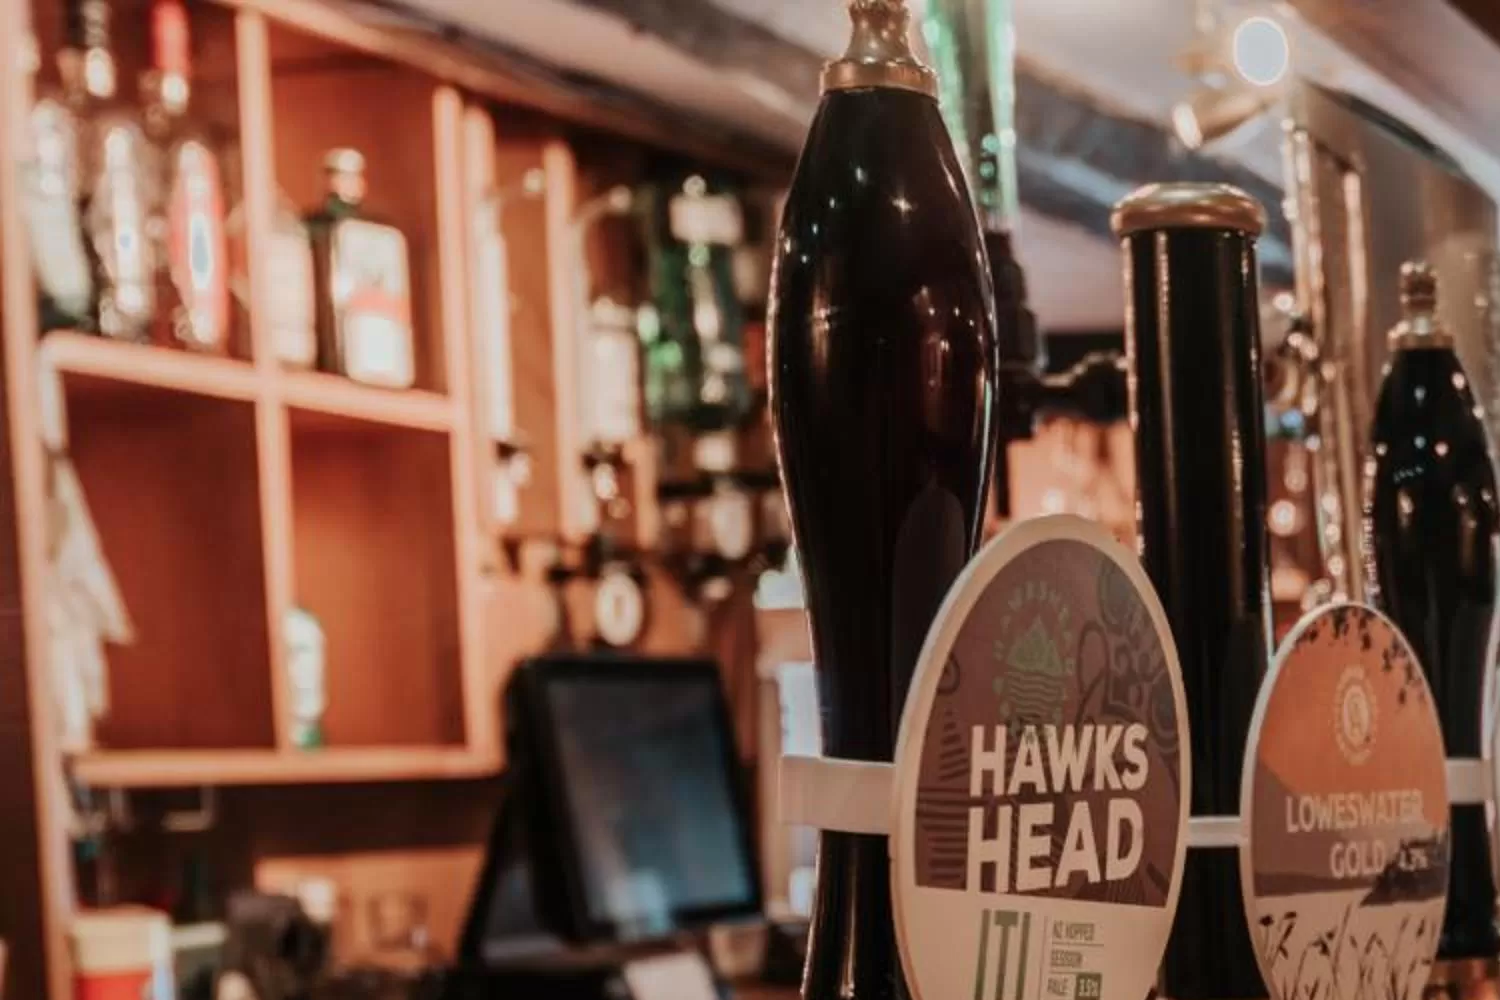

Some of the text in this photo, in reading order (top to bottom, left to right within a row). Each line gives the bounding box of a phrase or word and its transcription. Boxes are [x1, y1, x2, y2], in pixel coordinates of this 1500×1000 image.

[970, 723, 1149, 797] HAWKS
[1284, 788, 1424, 833] LOWESWATER
[966, 798, 1144, 893] HEAD
[1330, 840, 1386, 879] GOLD
